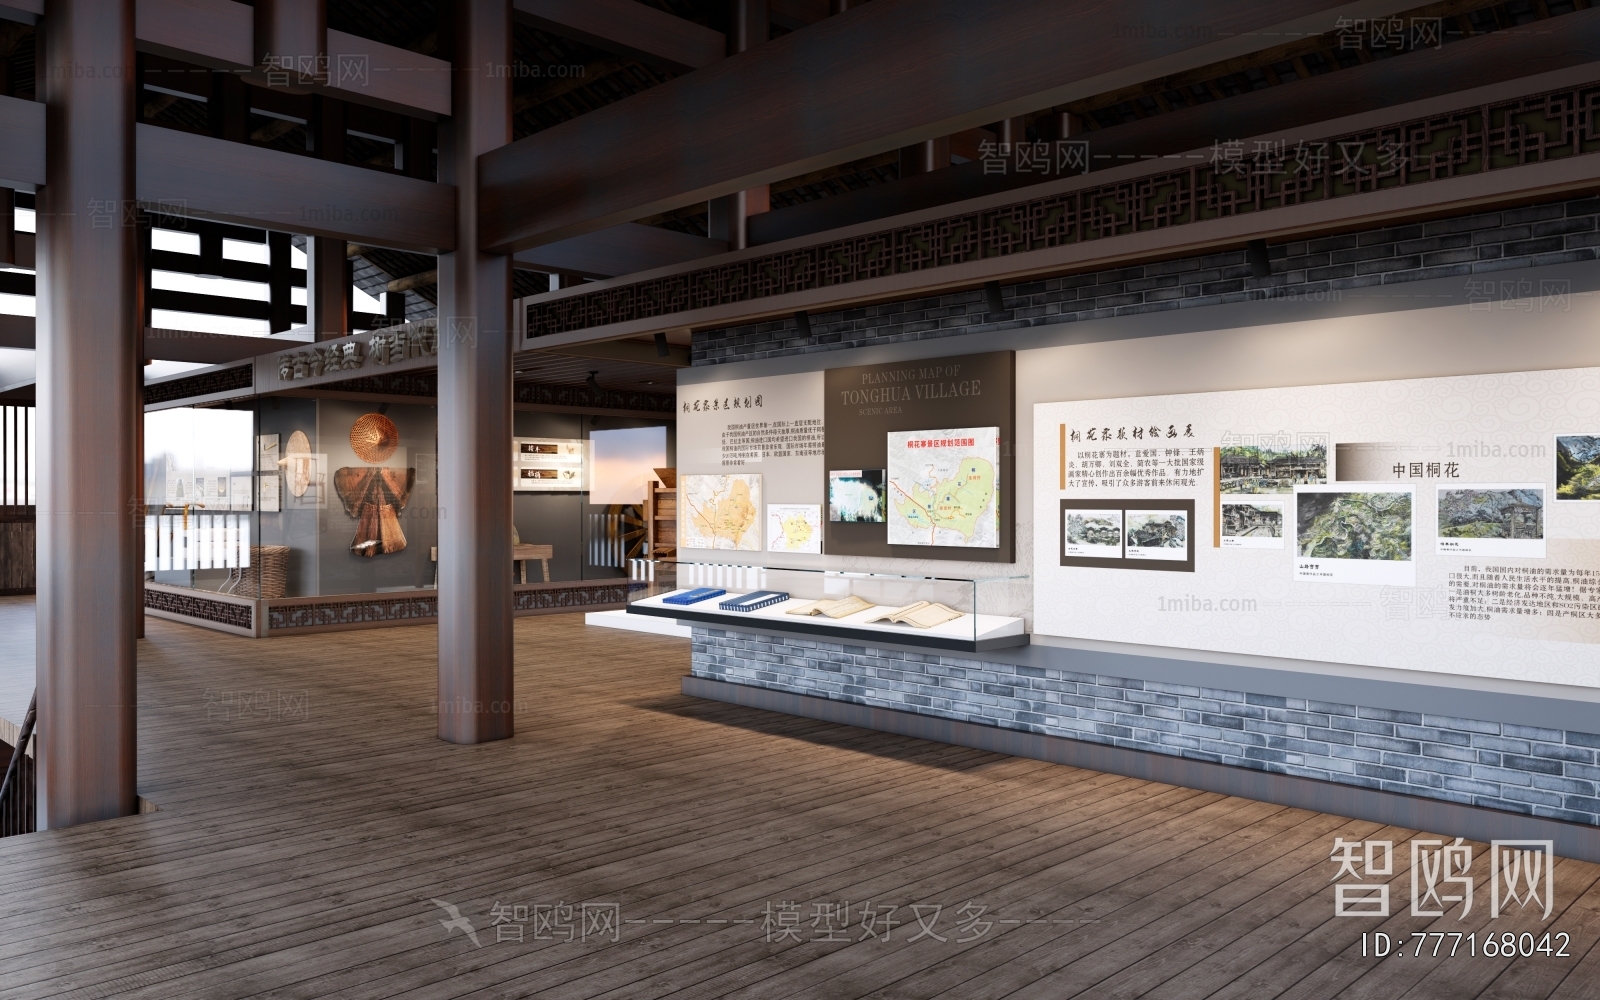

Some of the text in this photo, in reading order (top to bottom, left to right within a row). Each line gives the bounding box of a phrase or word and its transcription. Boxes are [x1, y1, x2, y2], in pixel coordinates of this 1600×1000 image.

[861, 364, 961, 385] PLANNING MAP OF
[841, 379, 981, 406] TONGHUA VILLAGE
[858, 406, 903, 417] SCENIC AREA
[1392, 461, 1460, 479] 中国桐花
